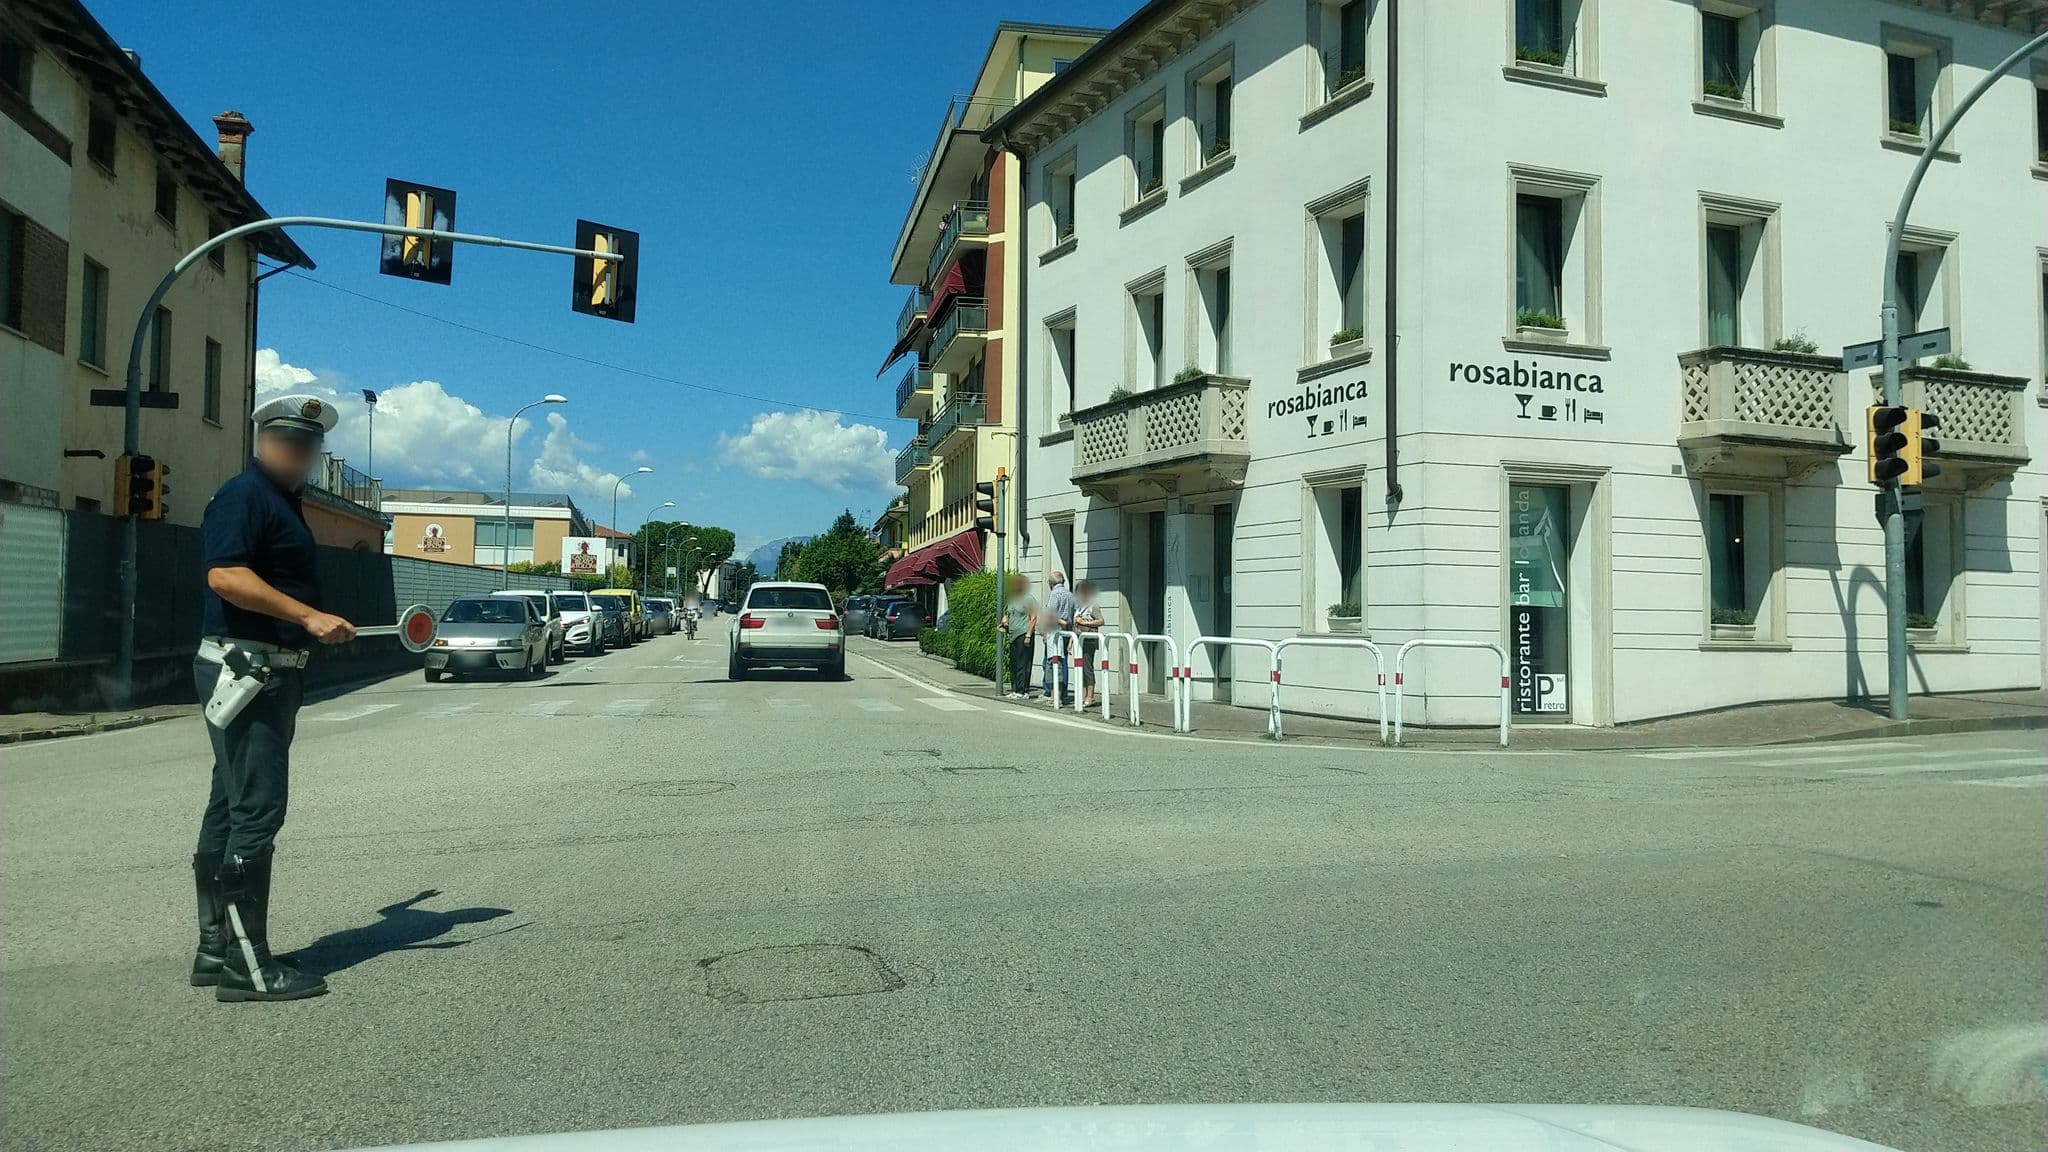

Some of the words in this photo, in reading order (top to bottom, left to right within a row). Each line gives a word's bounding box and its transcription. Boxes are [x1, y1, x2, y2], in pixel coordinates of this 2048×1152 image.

[1450, 360, 1604, 393] rosabianca
[1268, 380, 1368, 419] rosabianca
[1515, 490, 1530, 564] loanda
[1515, 572, 1530, 606] bar
[1517, 612, 1532, 712] ristorante
